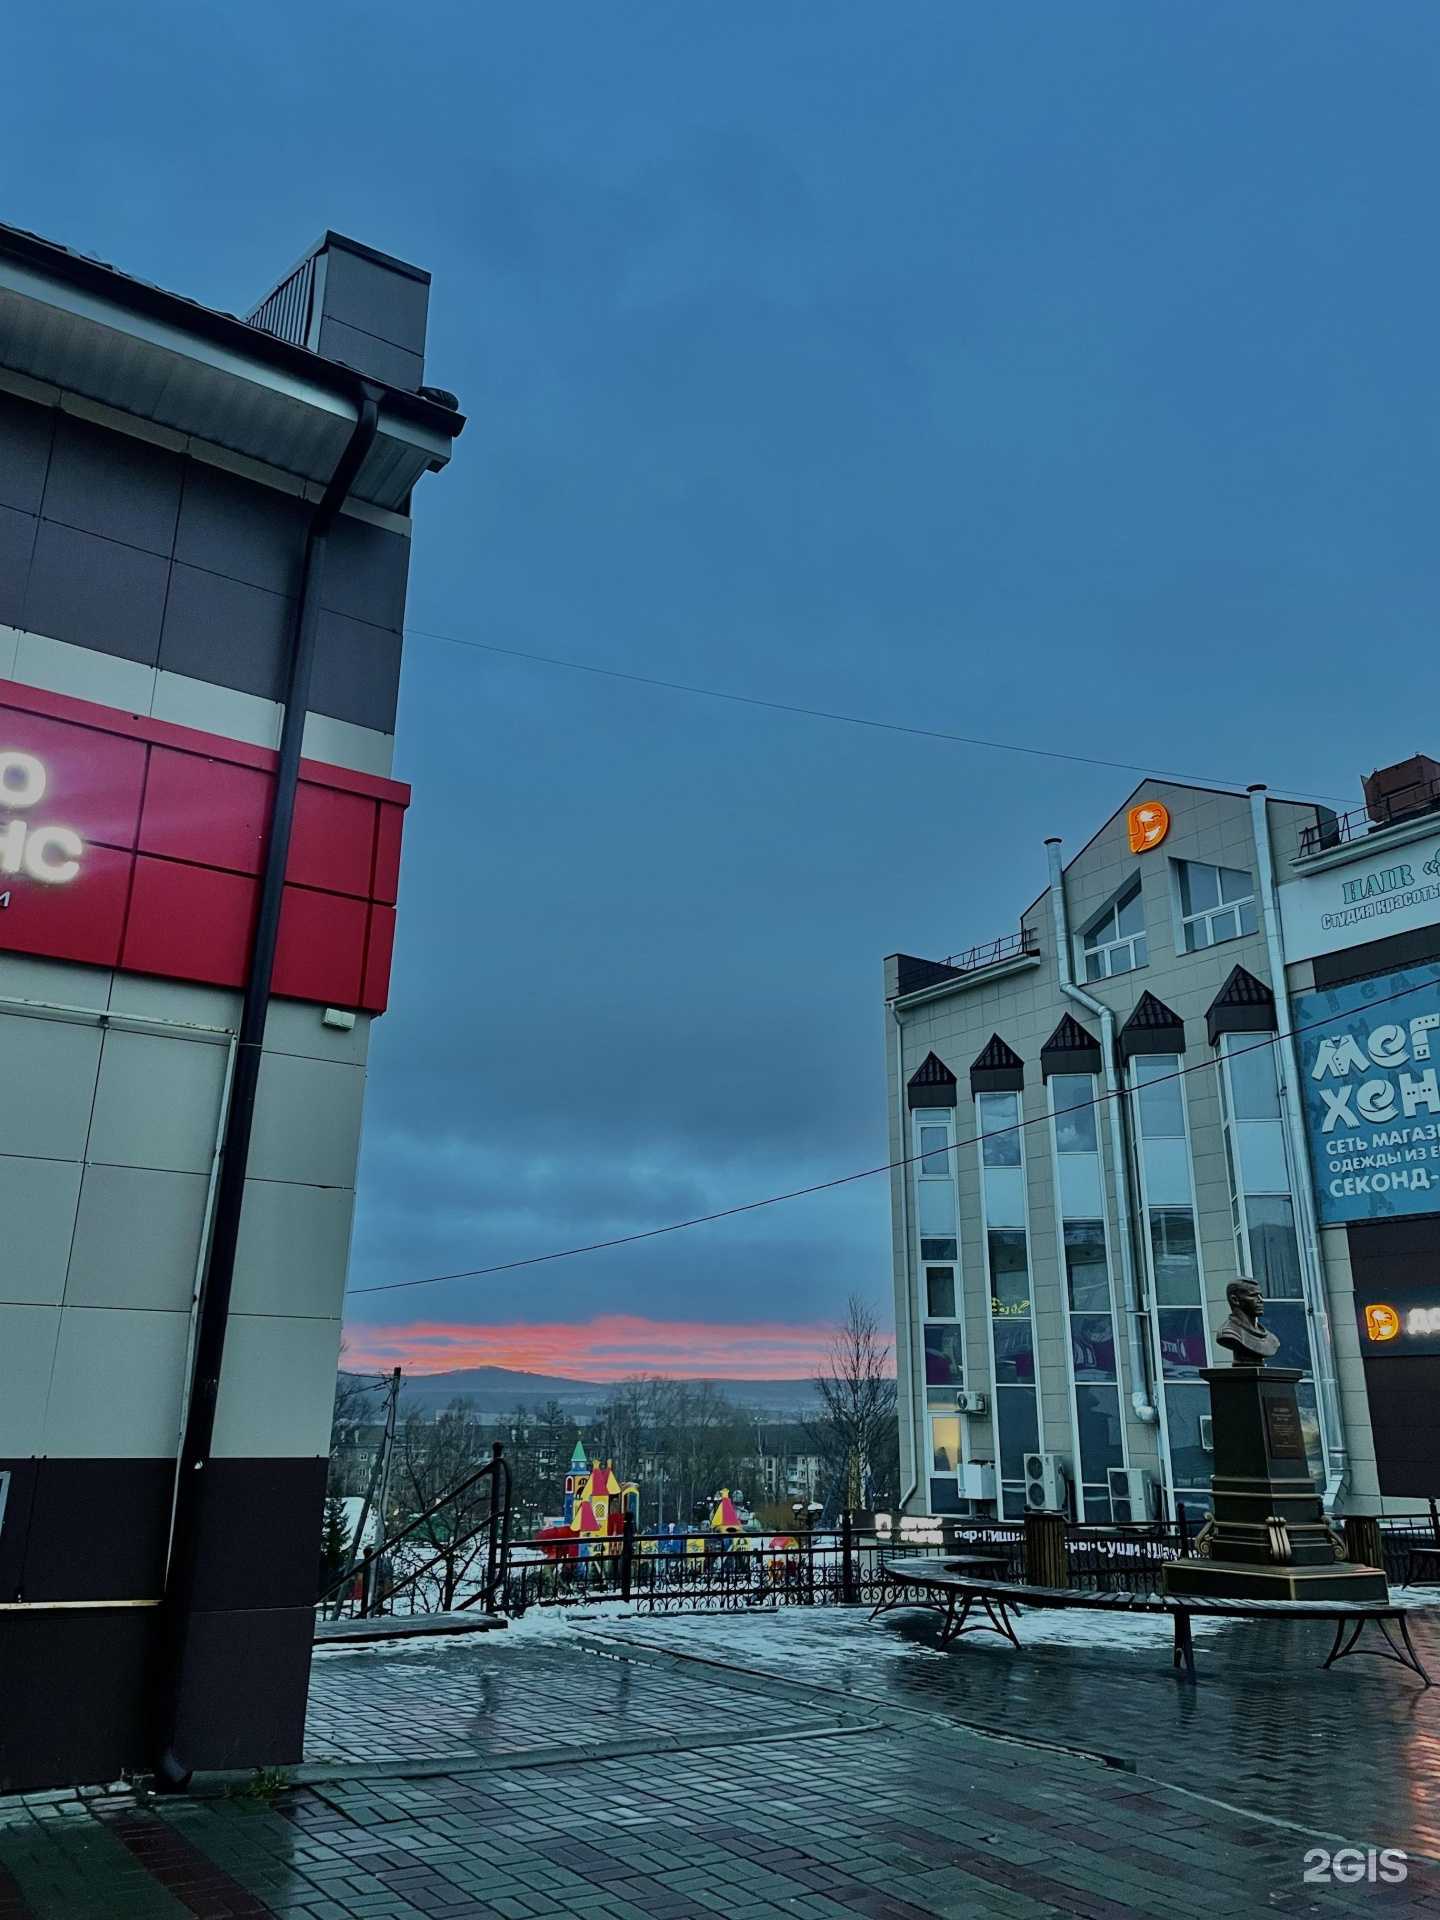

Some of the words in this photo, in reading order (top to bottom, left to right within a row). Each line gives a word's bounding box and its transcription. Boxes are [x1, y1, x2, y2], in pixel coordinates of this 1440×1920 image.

[1321, 902, 1376, 930] Студия
[1326, 1137, 1368, 1155] СЕТЬ
[1329, 1151, 1401, 1173] ОДЕЖДЫ
[1405, 1147, 1427, 1162] ИЗ
